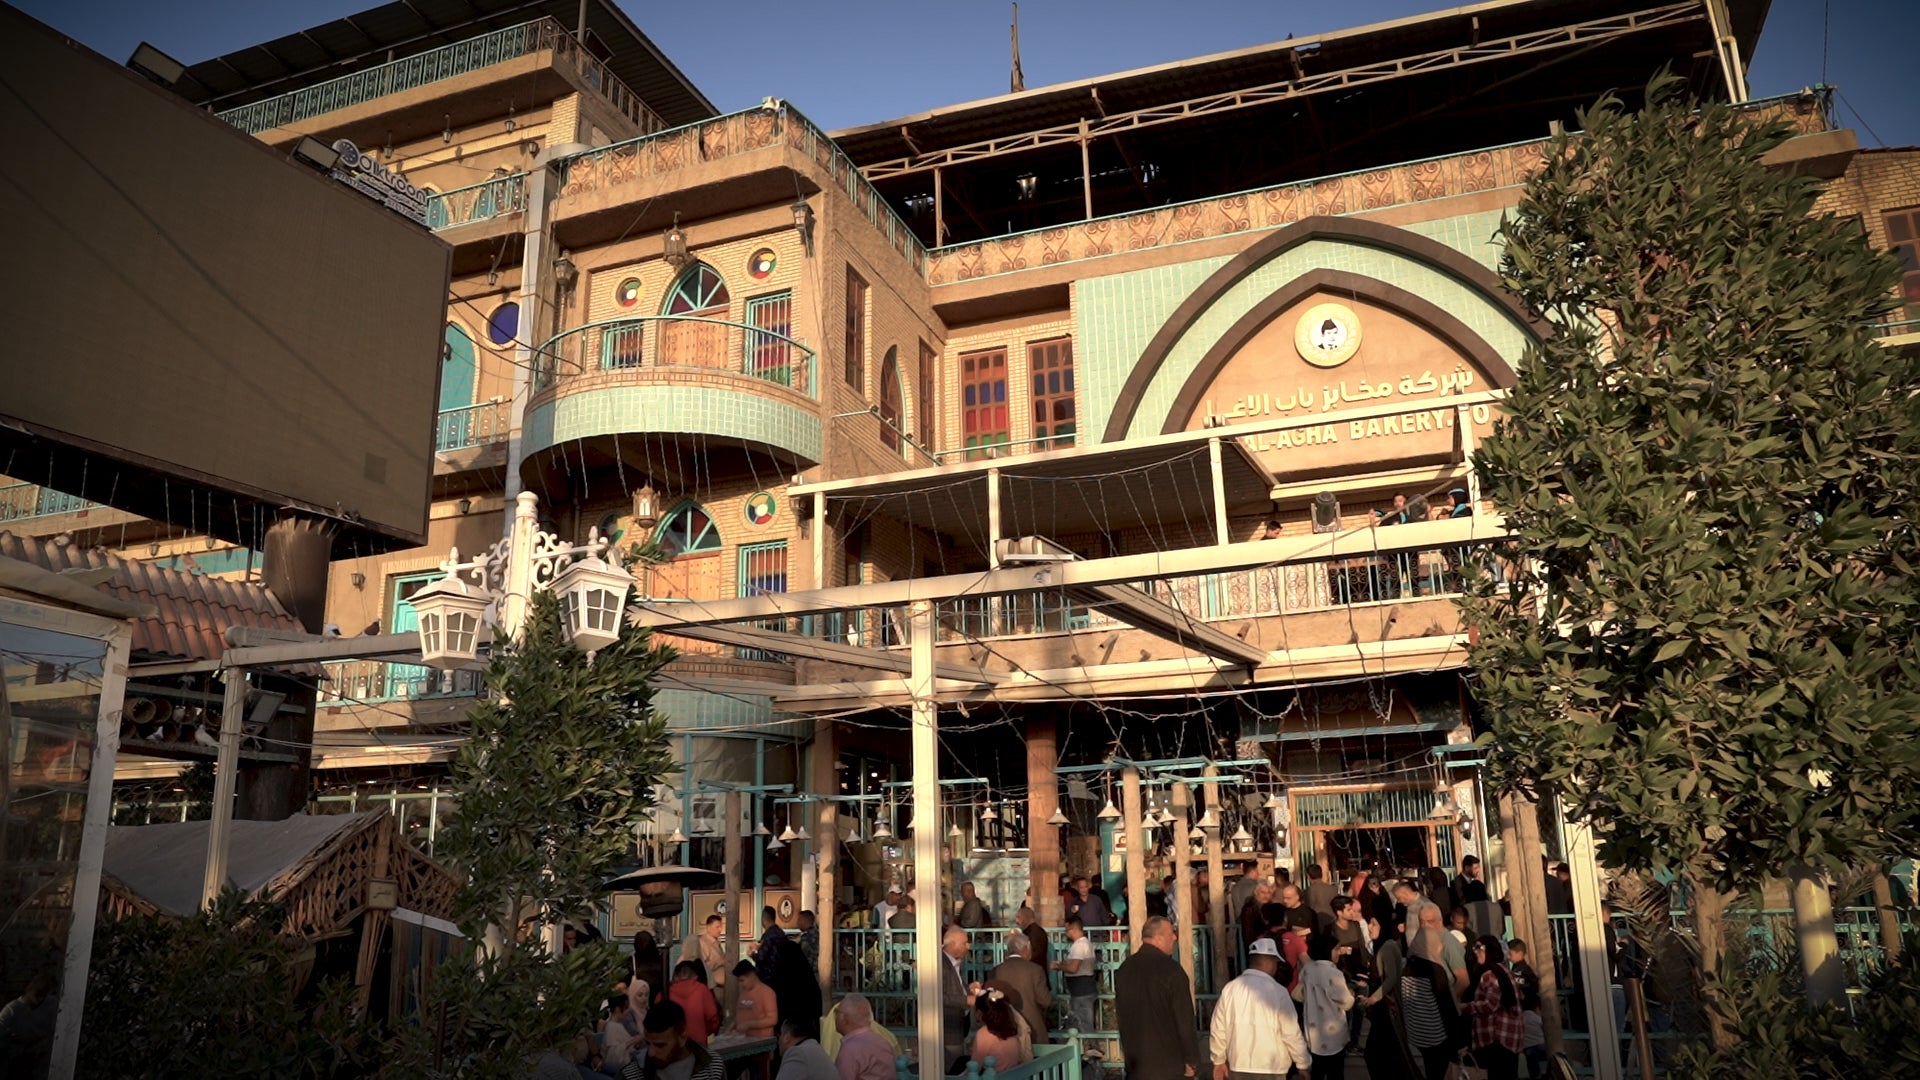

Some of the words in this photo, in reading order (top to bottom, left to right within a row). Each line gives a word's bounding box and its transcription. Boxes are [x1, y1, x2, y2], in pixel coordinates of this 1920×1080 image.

[1398, 363, 1473, 397] شركة
[1275, 386, 1314, 416] باب
[1321, 381, 1393, 413] مخابز
[1243, 424, 1338, 452] AL-AGHA
